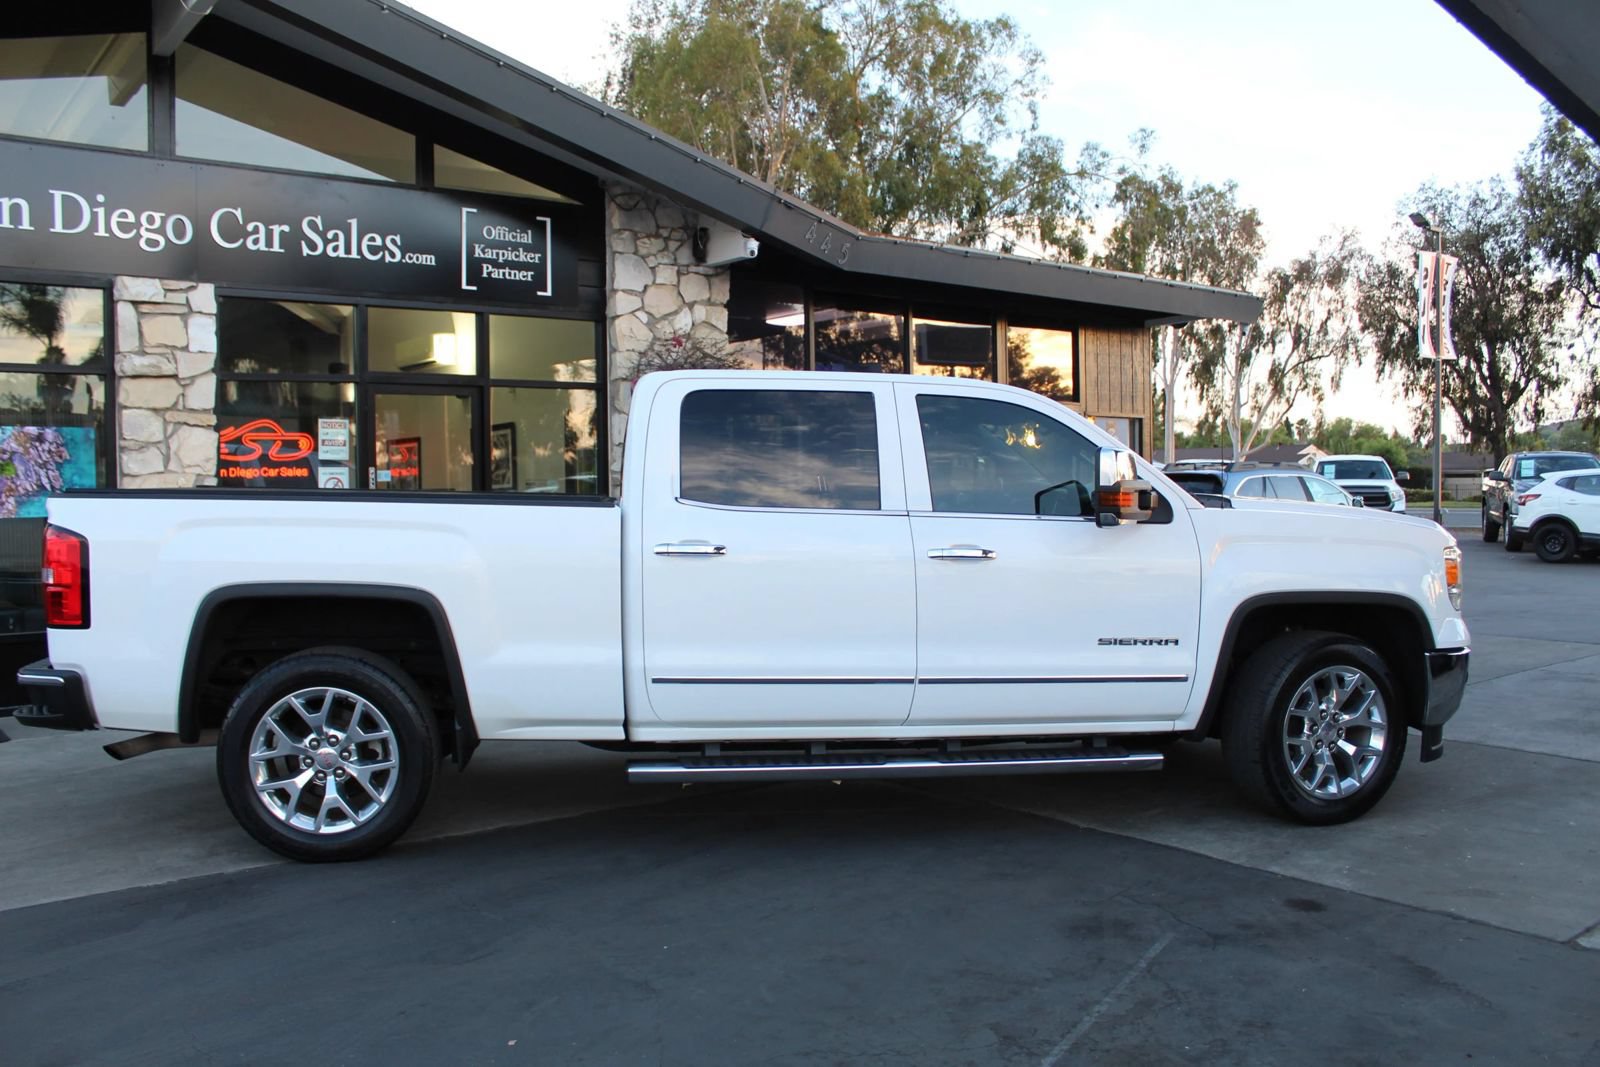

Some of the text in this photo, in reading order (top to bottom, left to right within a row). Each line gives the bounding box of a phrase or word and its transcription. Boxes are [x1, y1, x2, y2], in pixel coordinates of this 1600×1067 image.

[48, 189, 193, 252] Diego
[210, 207, 290, 252] Car
[482, 225, 532, 244] Official
[804, 221, 850, 265] 445
[473, 243, 541, 264] Karpicker
[481, 264, 534, 282] Partner
[228, 467, 259, 479] Diego
[260, 467, 279, 477] Car
[280, 467, 308, 477] Sales
[1098, 638, 1179, 646] SIERRA
